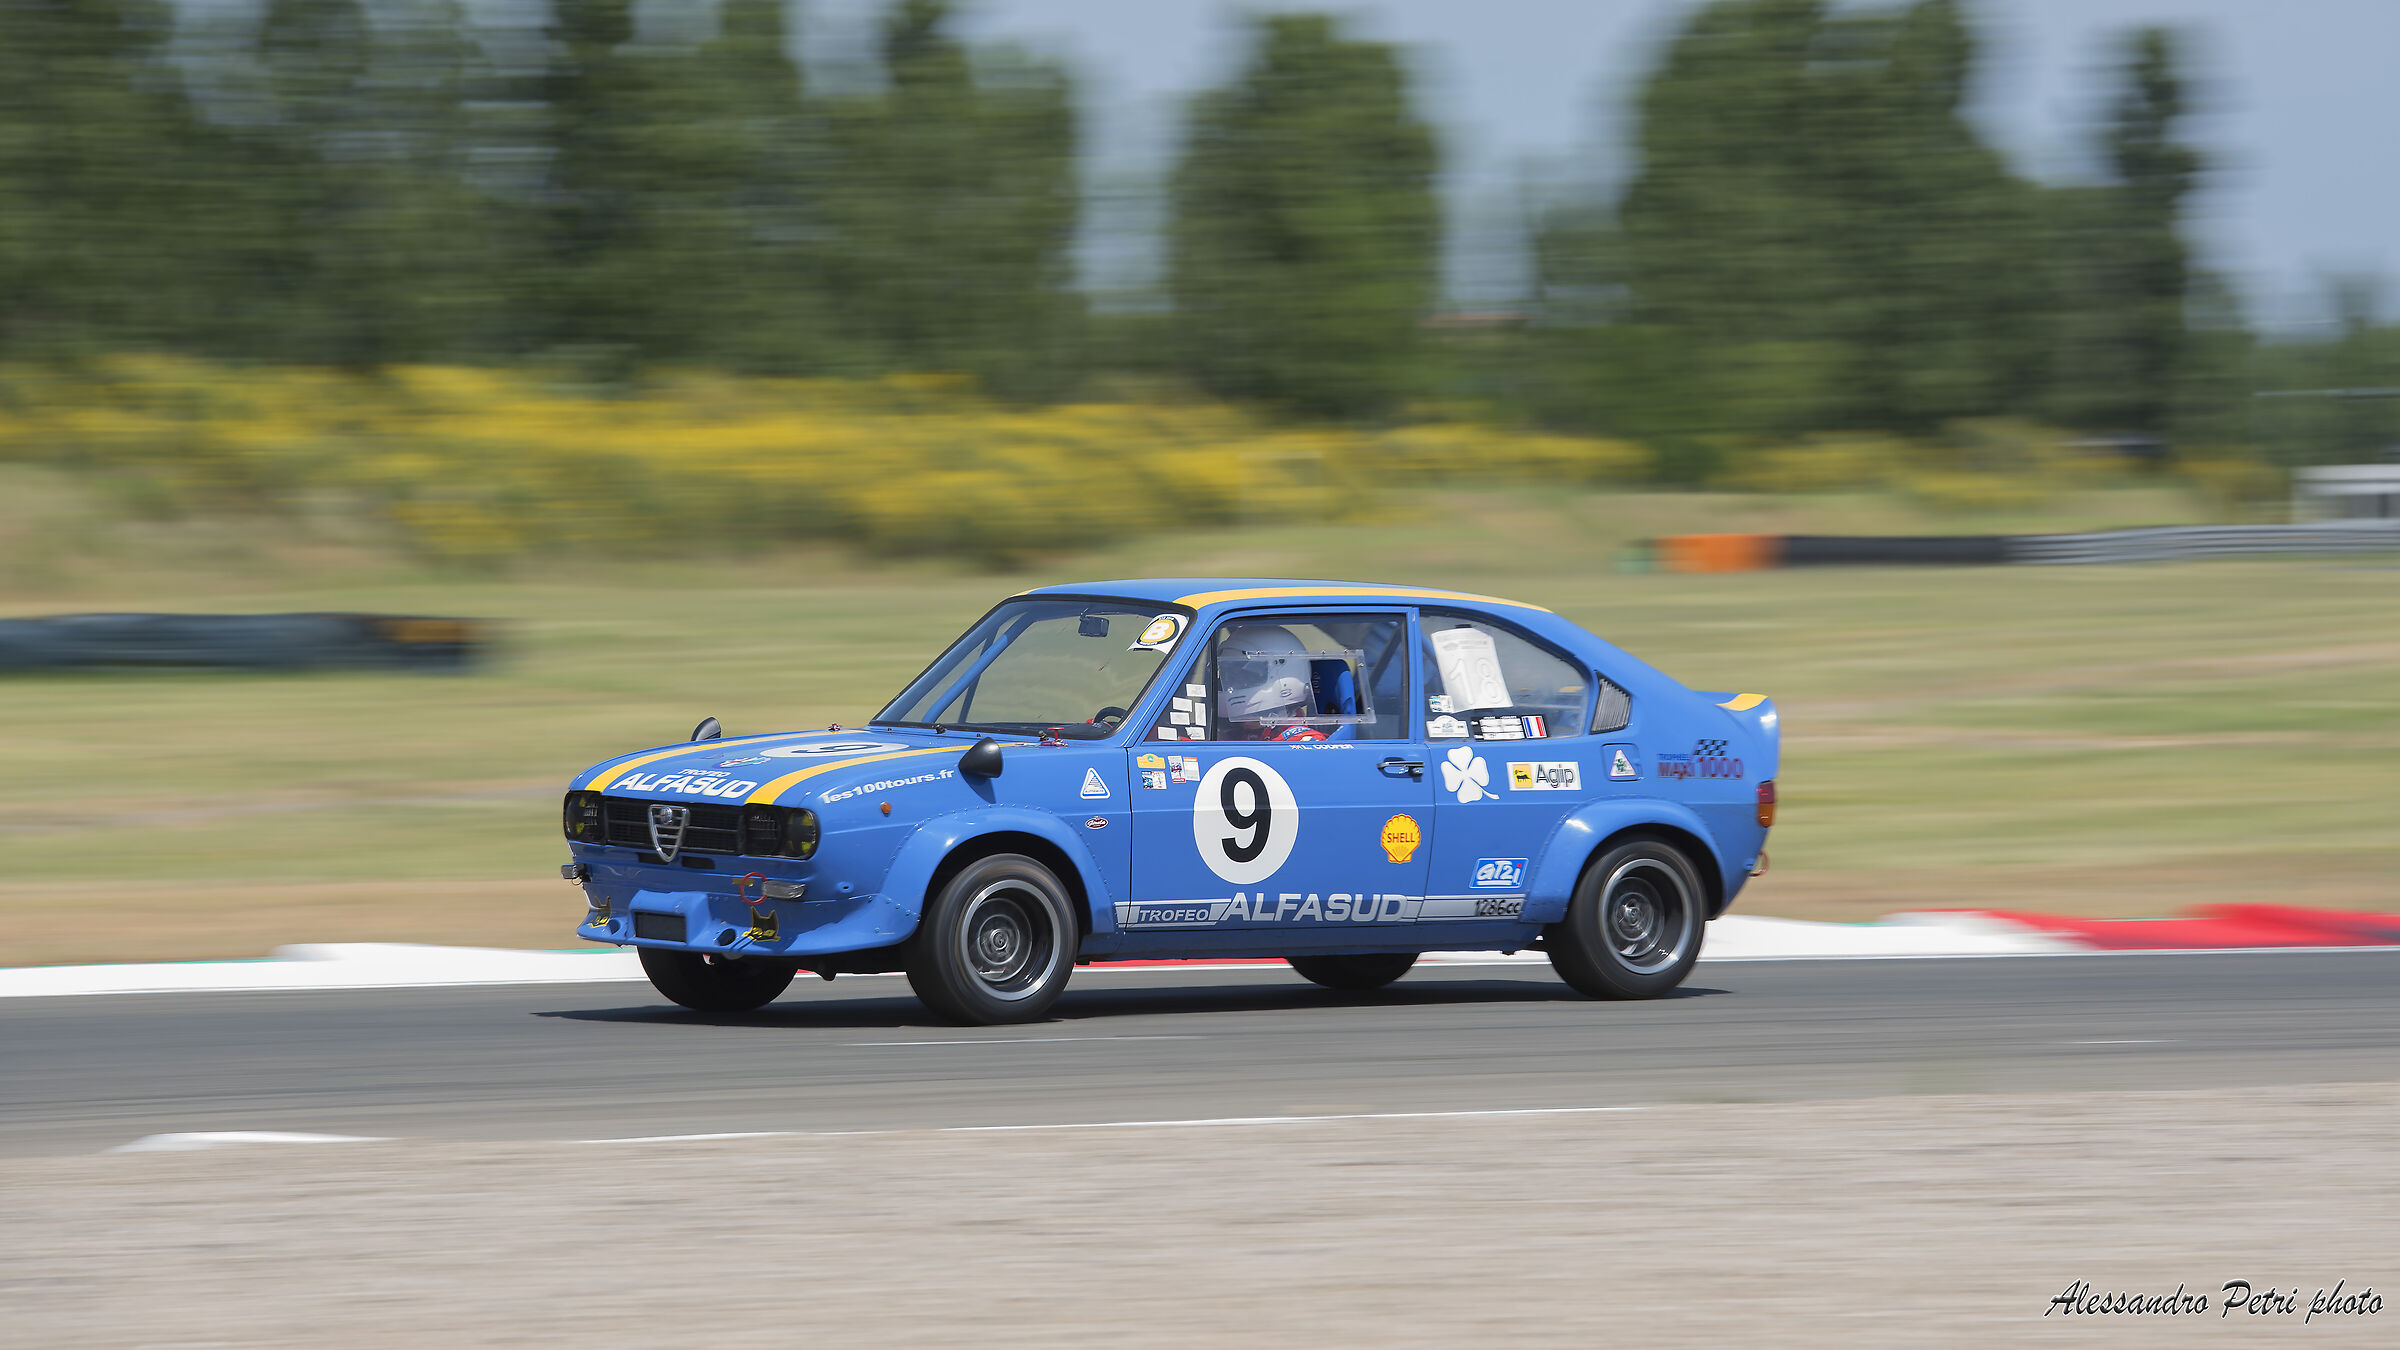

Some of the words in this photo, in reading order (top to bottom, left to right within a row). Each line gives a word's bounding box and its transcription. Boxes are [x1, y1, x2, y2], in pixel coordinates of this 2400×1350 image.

[677, 768, 735, 778] TROFEO
[1536, 764, 1575, 789] Agip
[1698, 756, 1744, 778] 1000
[610, 772, 758, 799] ALFASUD
[823, 769, 955, 804] les100tours.fr
[1220, 767, 1272, 863] 9
[1387, 832, 1416, 843] SHELL
[1139, 908, 1210, 923] TROFEO
[1220, 892, 1409, 923] ALFASUD
